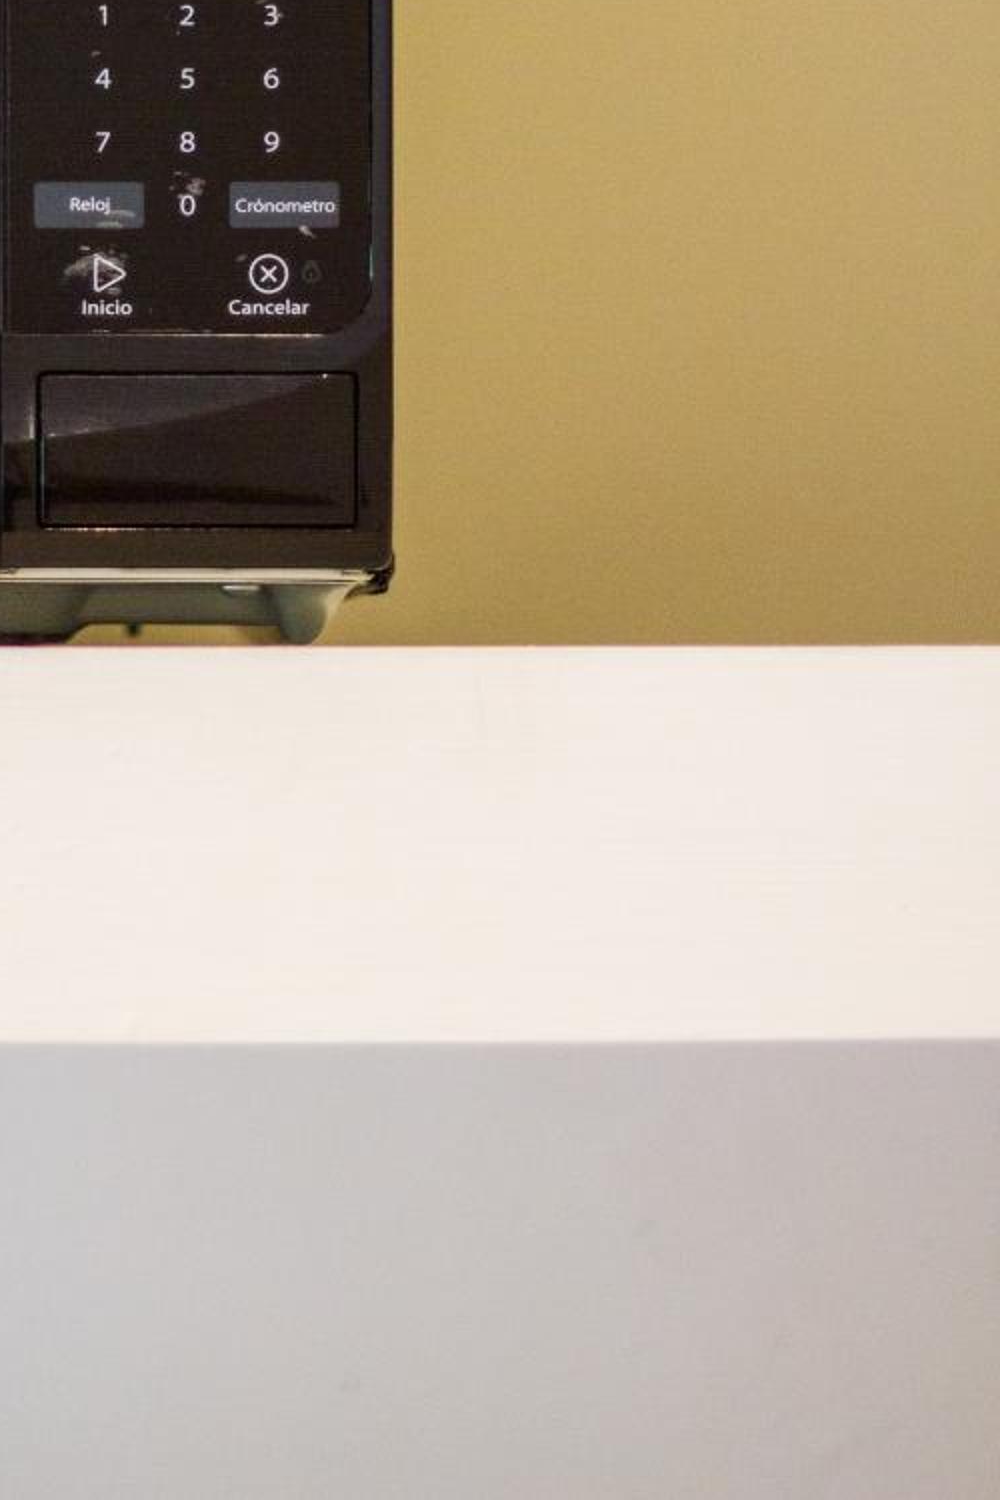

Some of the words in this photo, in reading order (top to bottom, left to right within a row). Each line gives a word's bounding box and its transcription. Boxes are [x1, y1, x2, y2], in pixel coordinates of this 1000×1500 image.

[99, 5, 107, 25] 1
[180, 5, 194, 26] 2
[264, 5, 279, 26] 3
[95, 68, 111, 89] 4
[181, 68, 194, 89] 5
[264, 68, 279, 89] 6
[96, 132, 110, 152] 7
[180, 132, 195, 152] 8
[264, 132, 280, 152] 9
[70, 197, 110, 214] Reloj
[179, 196, 196, 216] 0
[82, 300, 132, 315] Inicio
[229, 299, 309, 315] Cancelar
